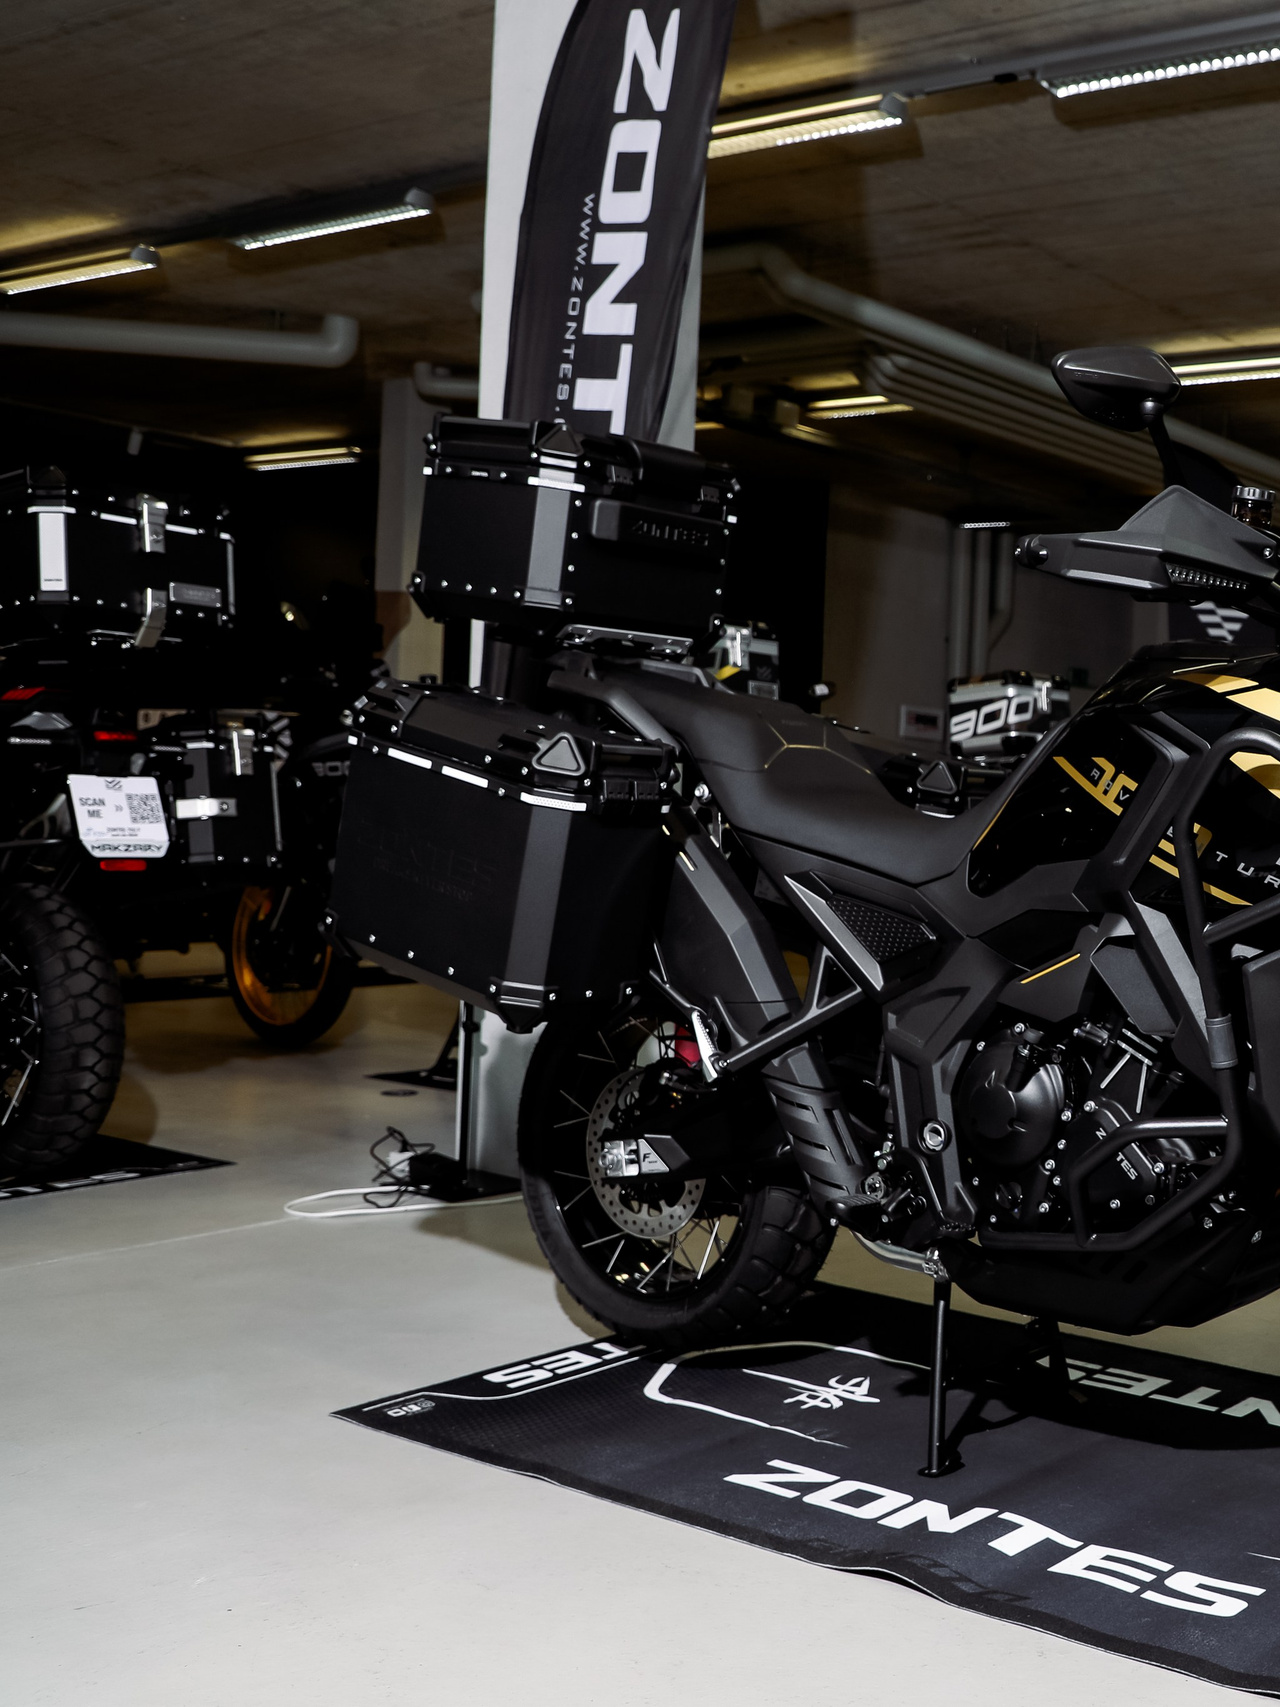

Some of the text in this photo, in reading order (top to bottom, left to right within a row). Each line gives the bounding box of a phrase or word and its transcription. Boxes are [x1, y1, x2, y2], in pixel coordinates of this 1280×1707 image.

[78, 797, 106, 807] SCAN
[87, 809, 104, 818] ME
[722, 1459, 1266, 1618] ZONTES
